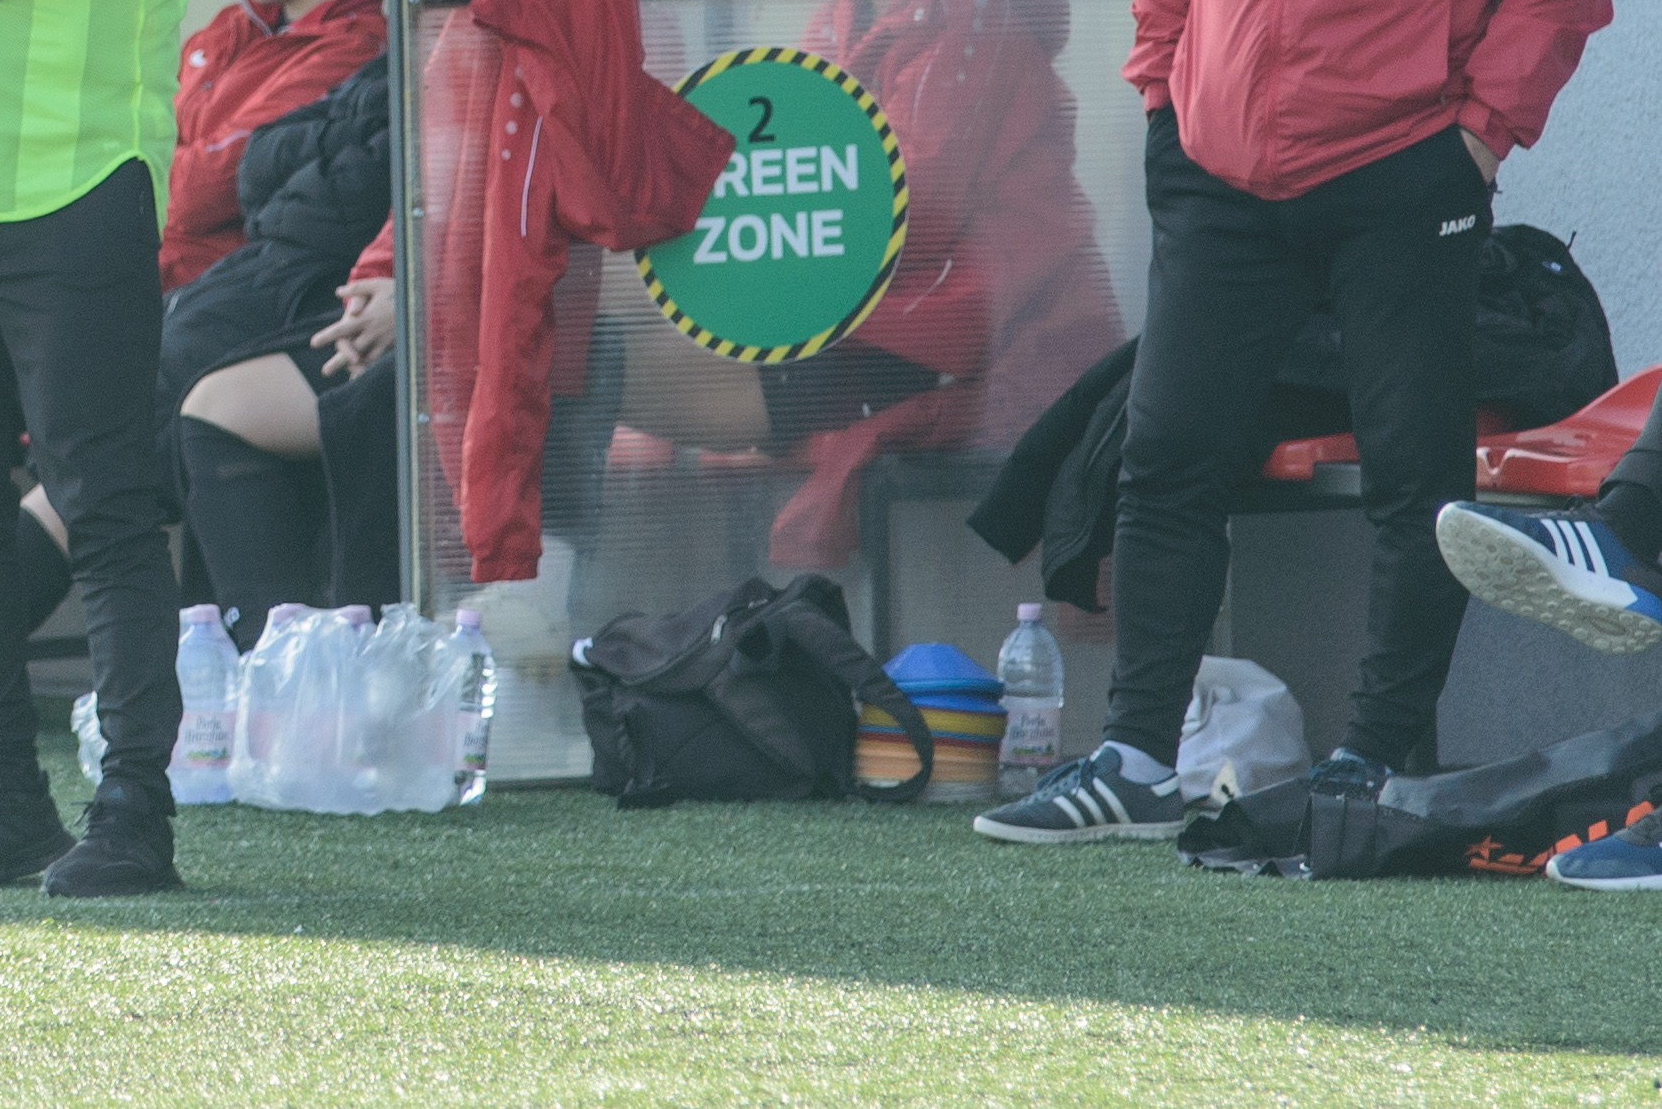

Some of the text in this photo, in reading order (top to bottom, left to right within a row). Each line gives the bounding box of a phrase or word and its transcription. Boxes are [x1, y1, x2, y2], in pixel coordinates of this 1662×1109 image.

[748, 95, 776, 143] 2
[713, 144, 859, 199] REEN
[693, 209, 845, 264] ZONE
[1439, 214, 1476, 237] JAKO
